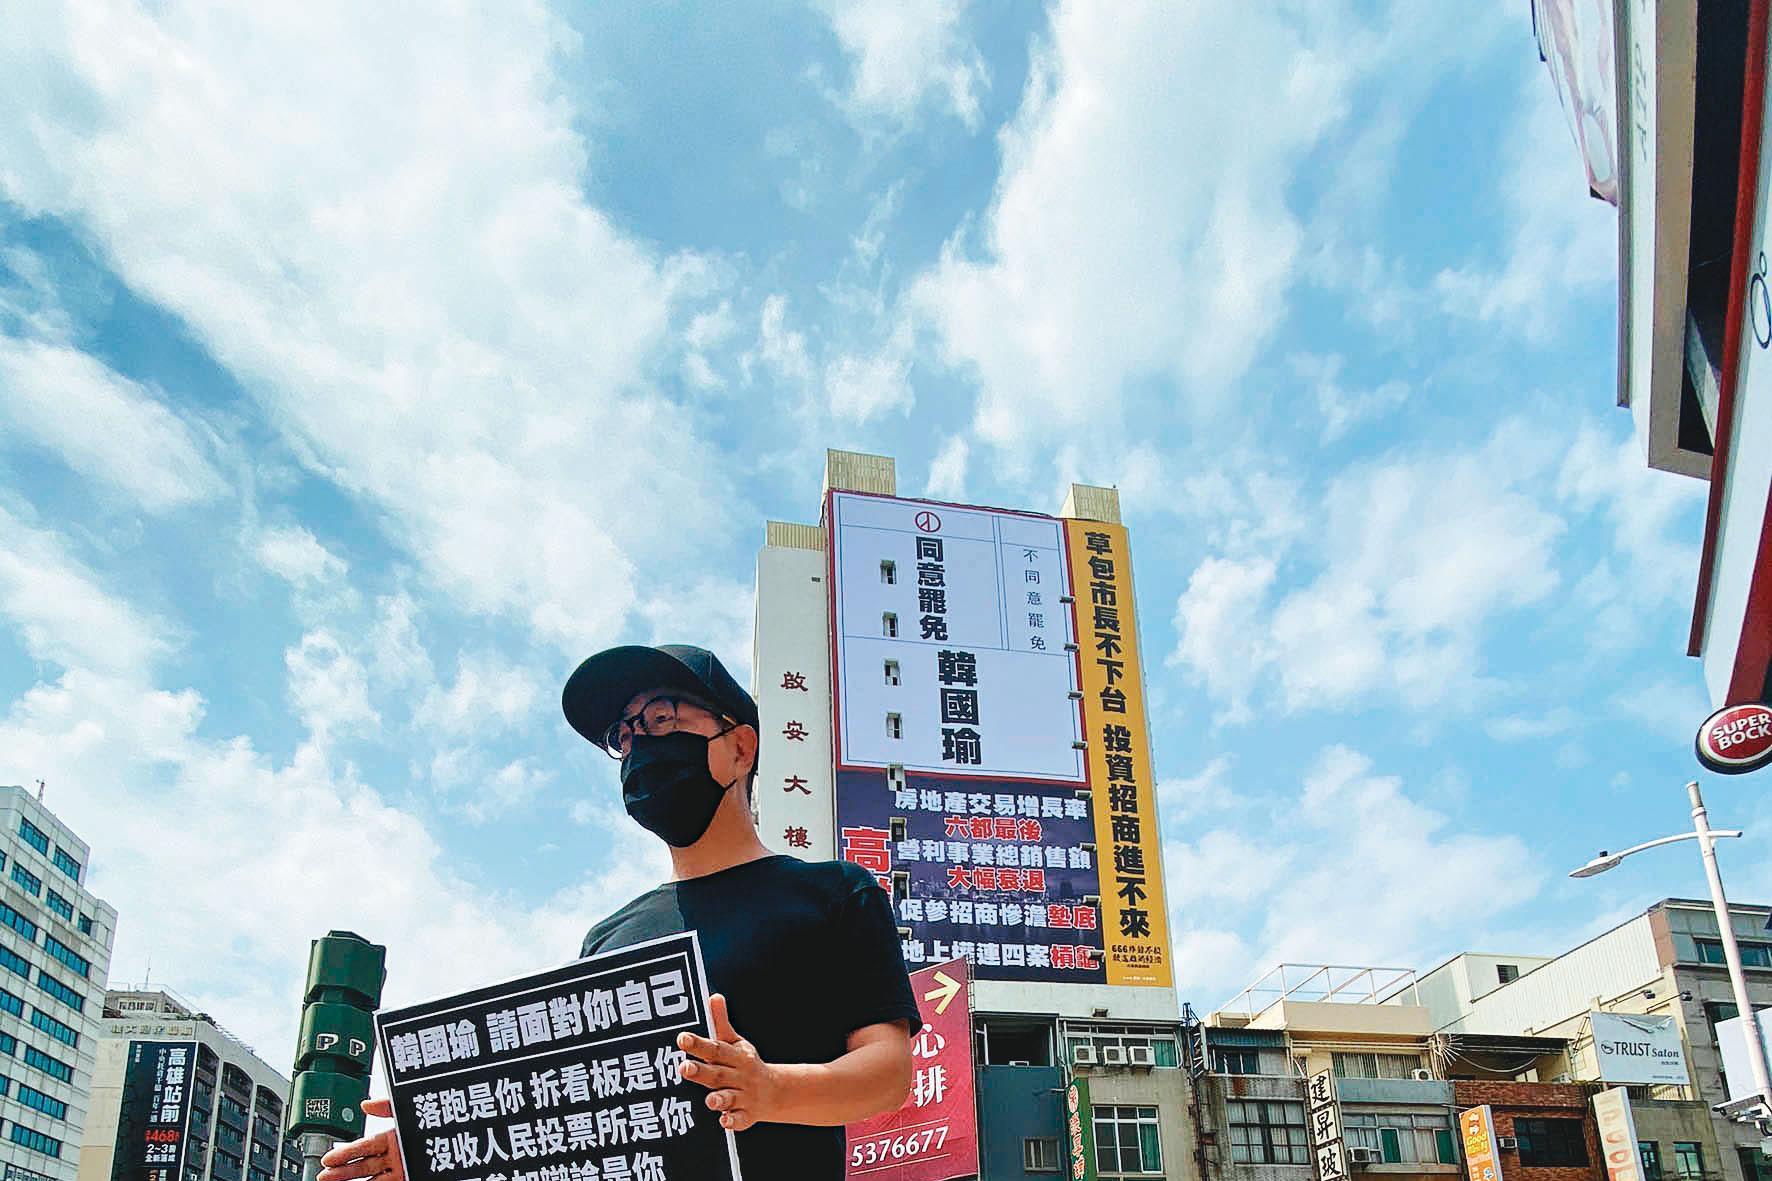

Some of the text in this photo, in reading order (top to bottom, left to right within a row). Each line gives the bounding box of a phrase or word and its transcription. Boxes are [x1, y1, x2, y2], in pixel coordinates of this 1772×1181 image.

[915, 536, 949, 641] 同意罷免
[1023, 549, 1046, 650] 不同意罷免
[1084, 530, 1128, 714] 草包市長不下台
[937, 649, 982, 765] 韓國瑜
[1712, 713, 1771, 740] SUPER
[1718, 724, 1771, 751] BOCK
[780, 671, 813, 849] 啟安大樓
[895, 788, 1088, 820] 房地產交易增長率
[944, 815, 1043, 842] 六都最後
[1103, 723, 1151, 939] 投資招商進不來
[897, 839, 1092, 870] 營利事業總銷售額
[947, 866, 1046, 893] 大幅衰退
[391, 969, 689, 1073] 韓國瑜 請面對你自己
[1614, 1042, 1679, 1058] TRUST Salon
[160, 1048, 187, 1123] 高雄站前
[413, 1046, 688, 1129] 落跑是你 拆看板是你
[426, 1096, 695, 1172] 沒收人民投票所是你
[851, 1126, 949, 1167] 5376677
